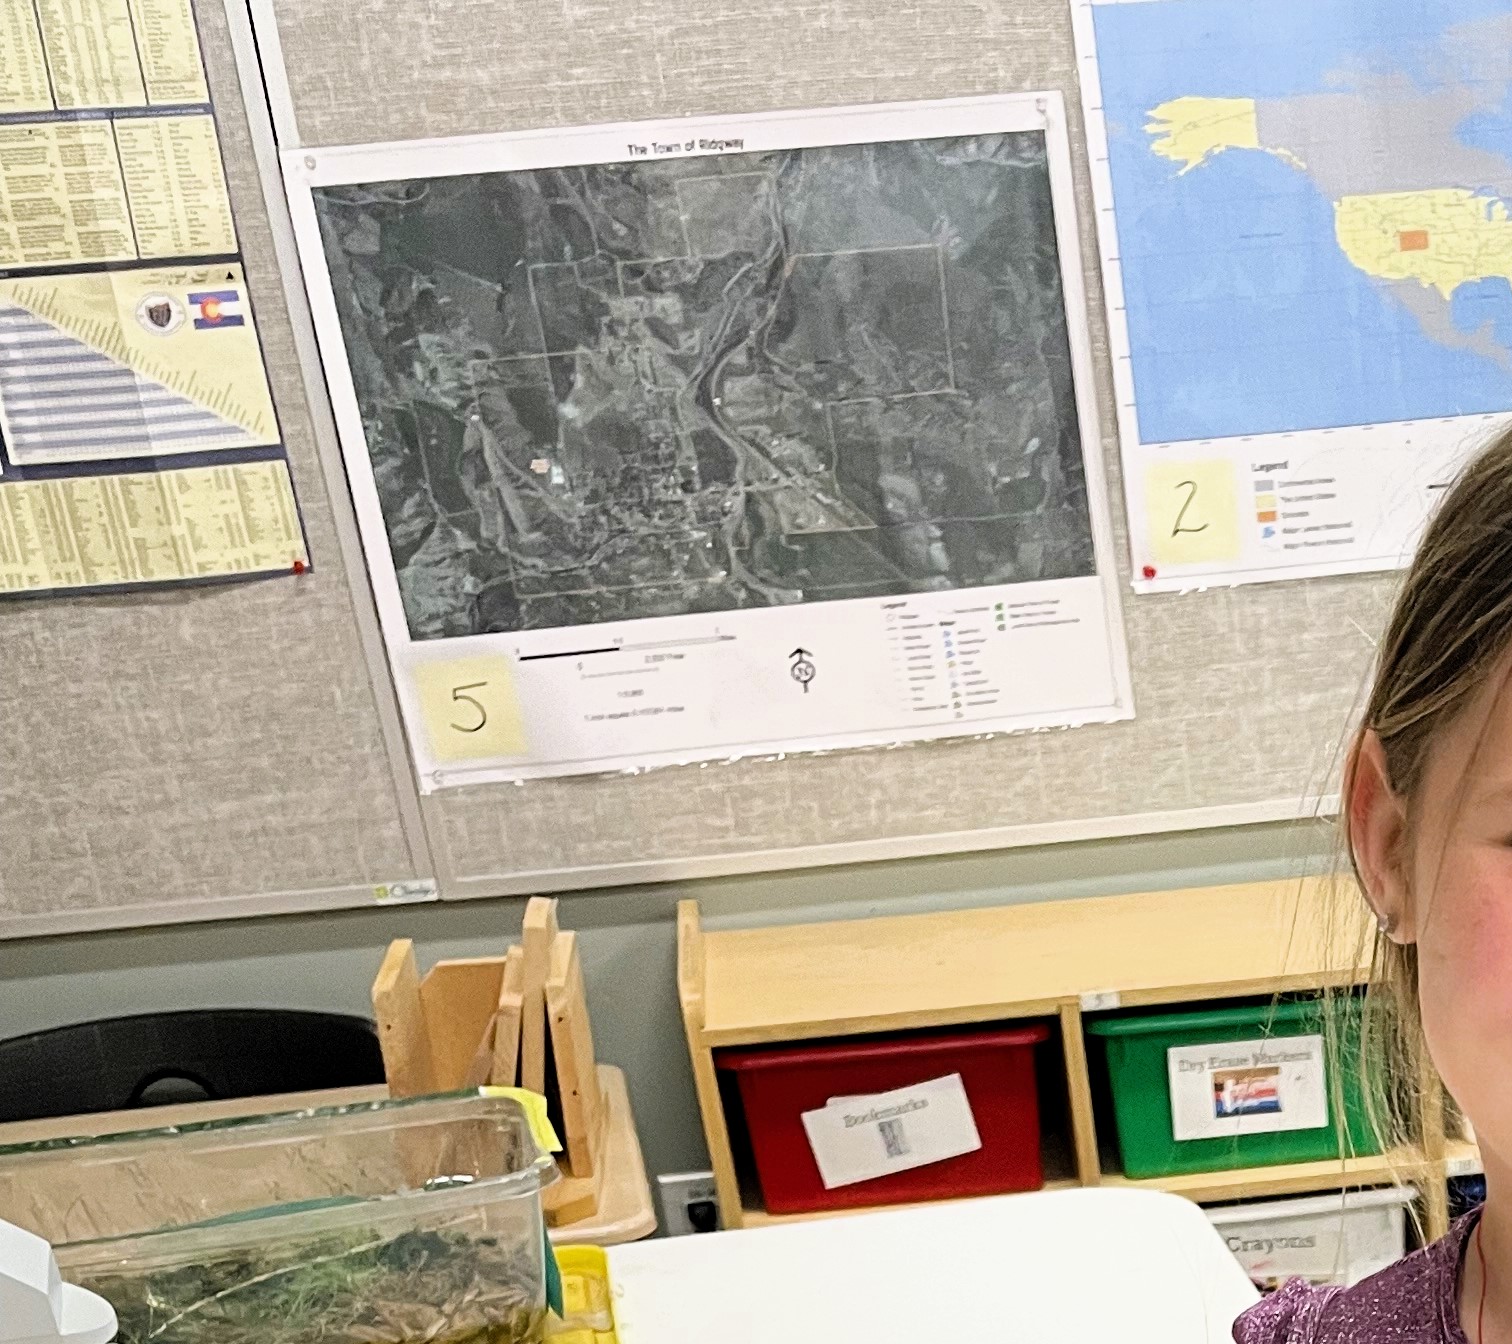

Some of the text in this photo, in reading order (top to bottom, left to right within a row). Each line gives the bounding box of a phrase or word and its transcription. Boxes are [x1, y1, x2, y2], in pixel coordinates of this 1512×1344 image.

[626, 144, 648, 156] The
[1171, 480, 1210, 538] 2
[450, 681, 488, 733] 5
[1225, 1234, 1317, 1255] Crayons
